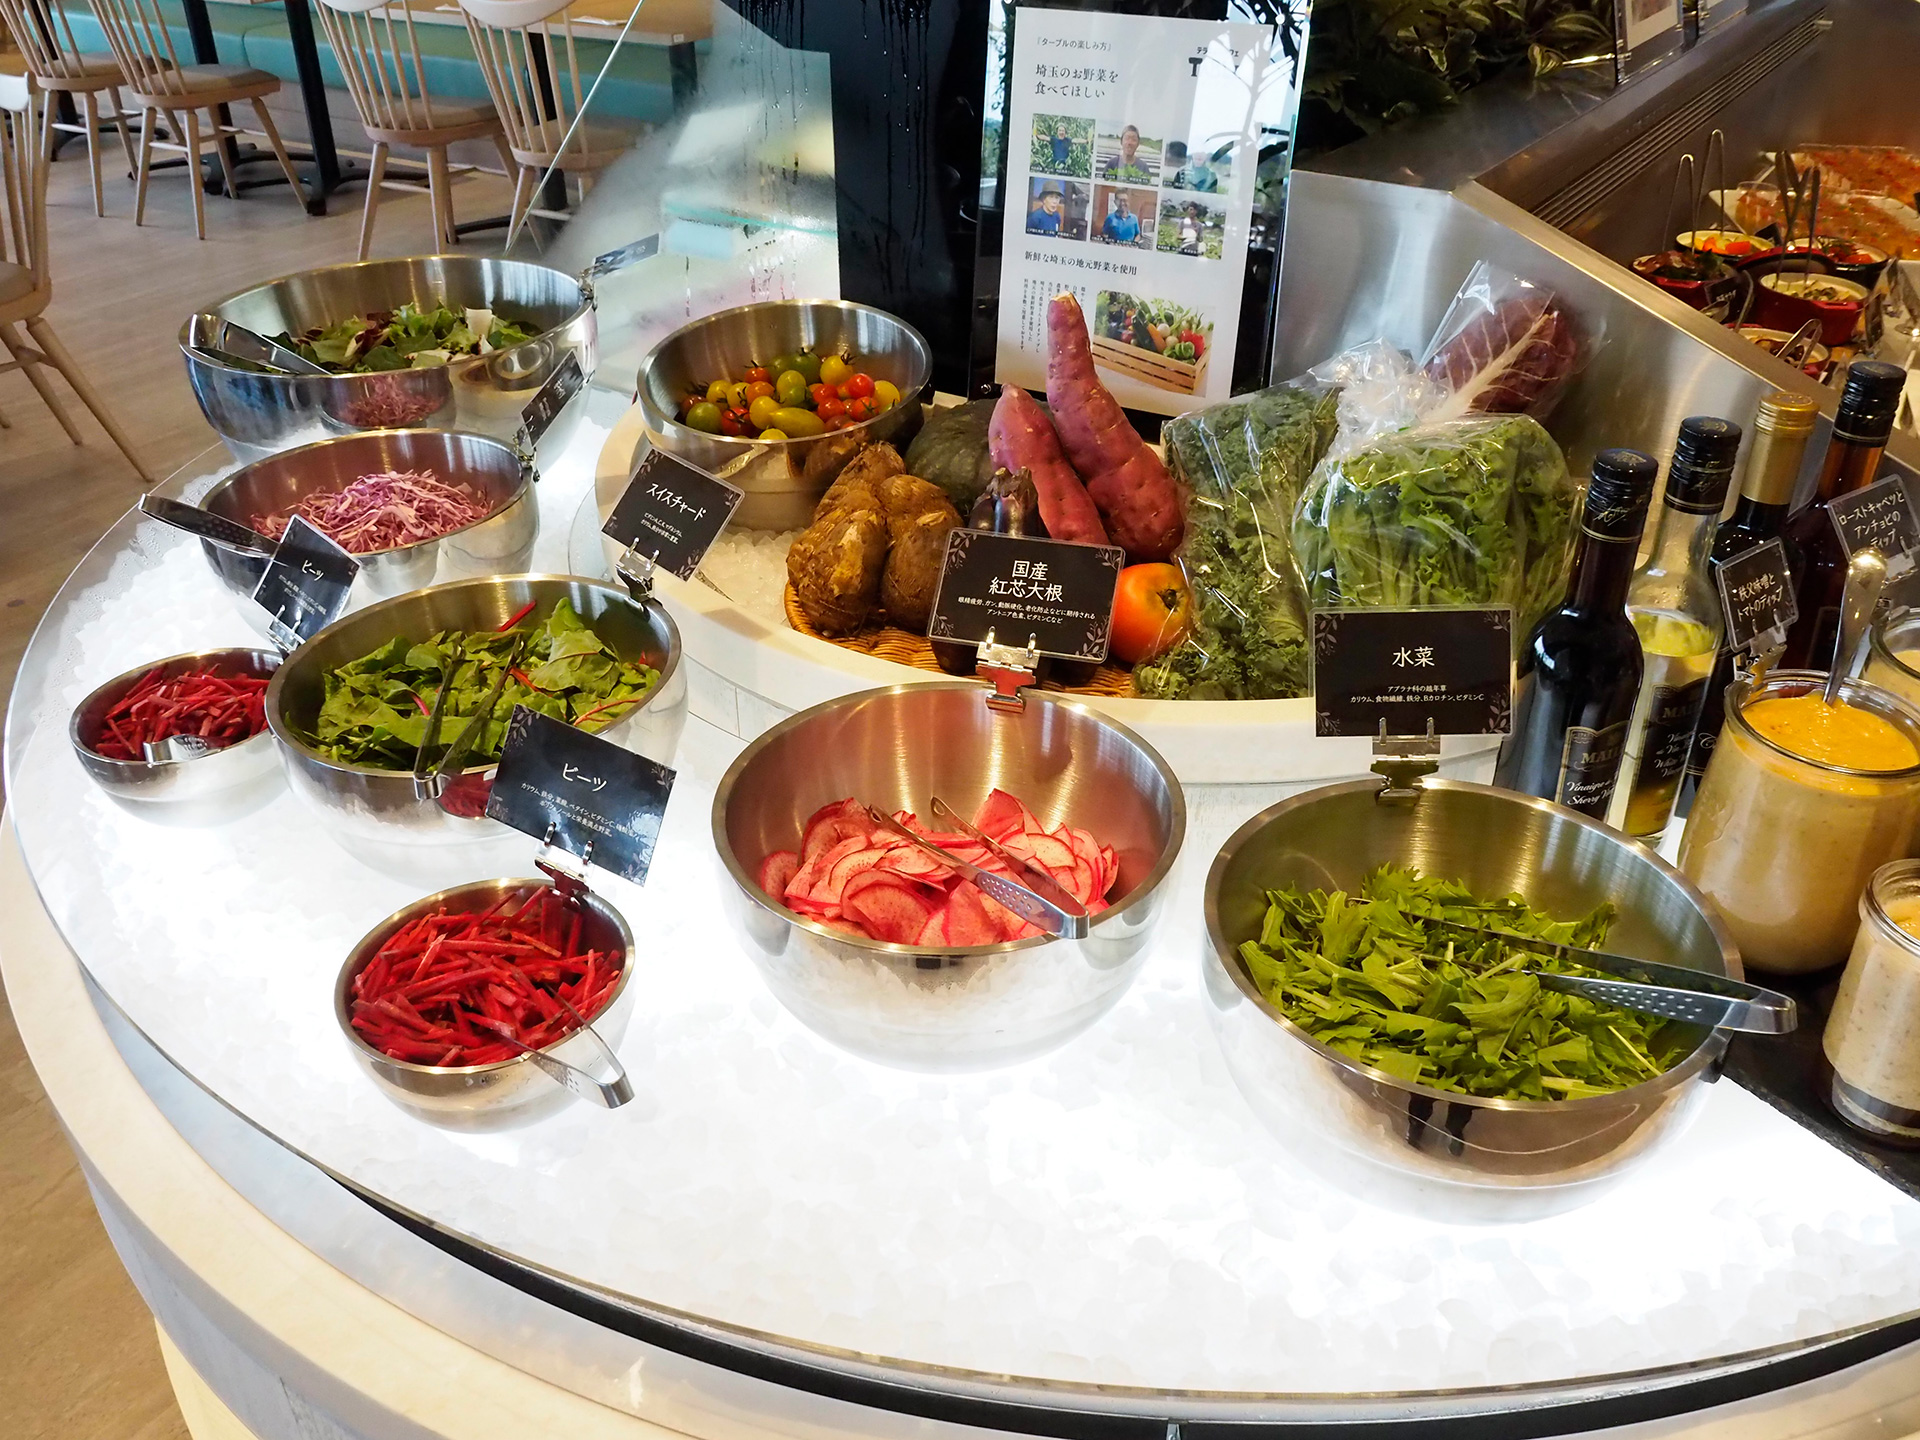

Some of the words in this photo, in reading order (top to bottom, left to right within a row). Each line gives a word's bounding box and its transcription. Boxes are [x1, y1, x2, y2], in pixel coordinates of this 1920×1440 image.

[1035, 63, 1119, 84] 埼玉のお野菜を
[1034, 80, 1106, 99] 食べてほしい
[1024, 250, 1138, 276] 新鮮な埼玉の地元野菜を使用
[646, 483, 707, 521] スイスチャード
[1838, 490, 1905, 526] ローストキャベツと
[1011, 560, 1049, 581] 国産
[988, 576, 1064, 603] 紅芯大根
[1391, 646, 1436, 668] 水菜
[561, 762, 608, 793] ビーツ
